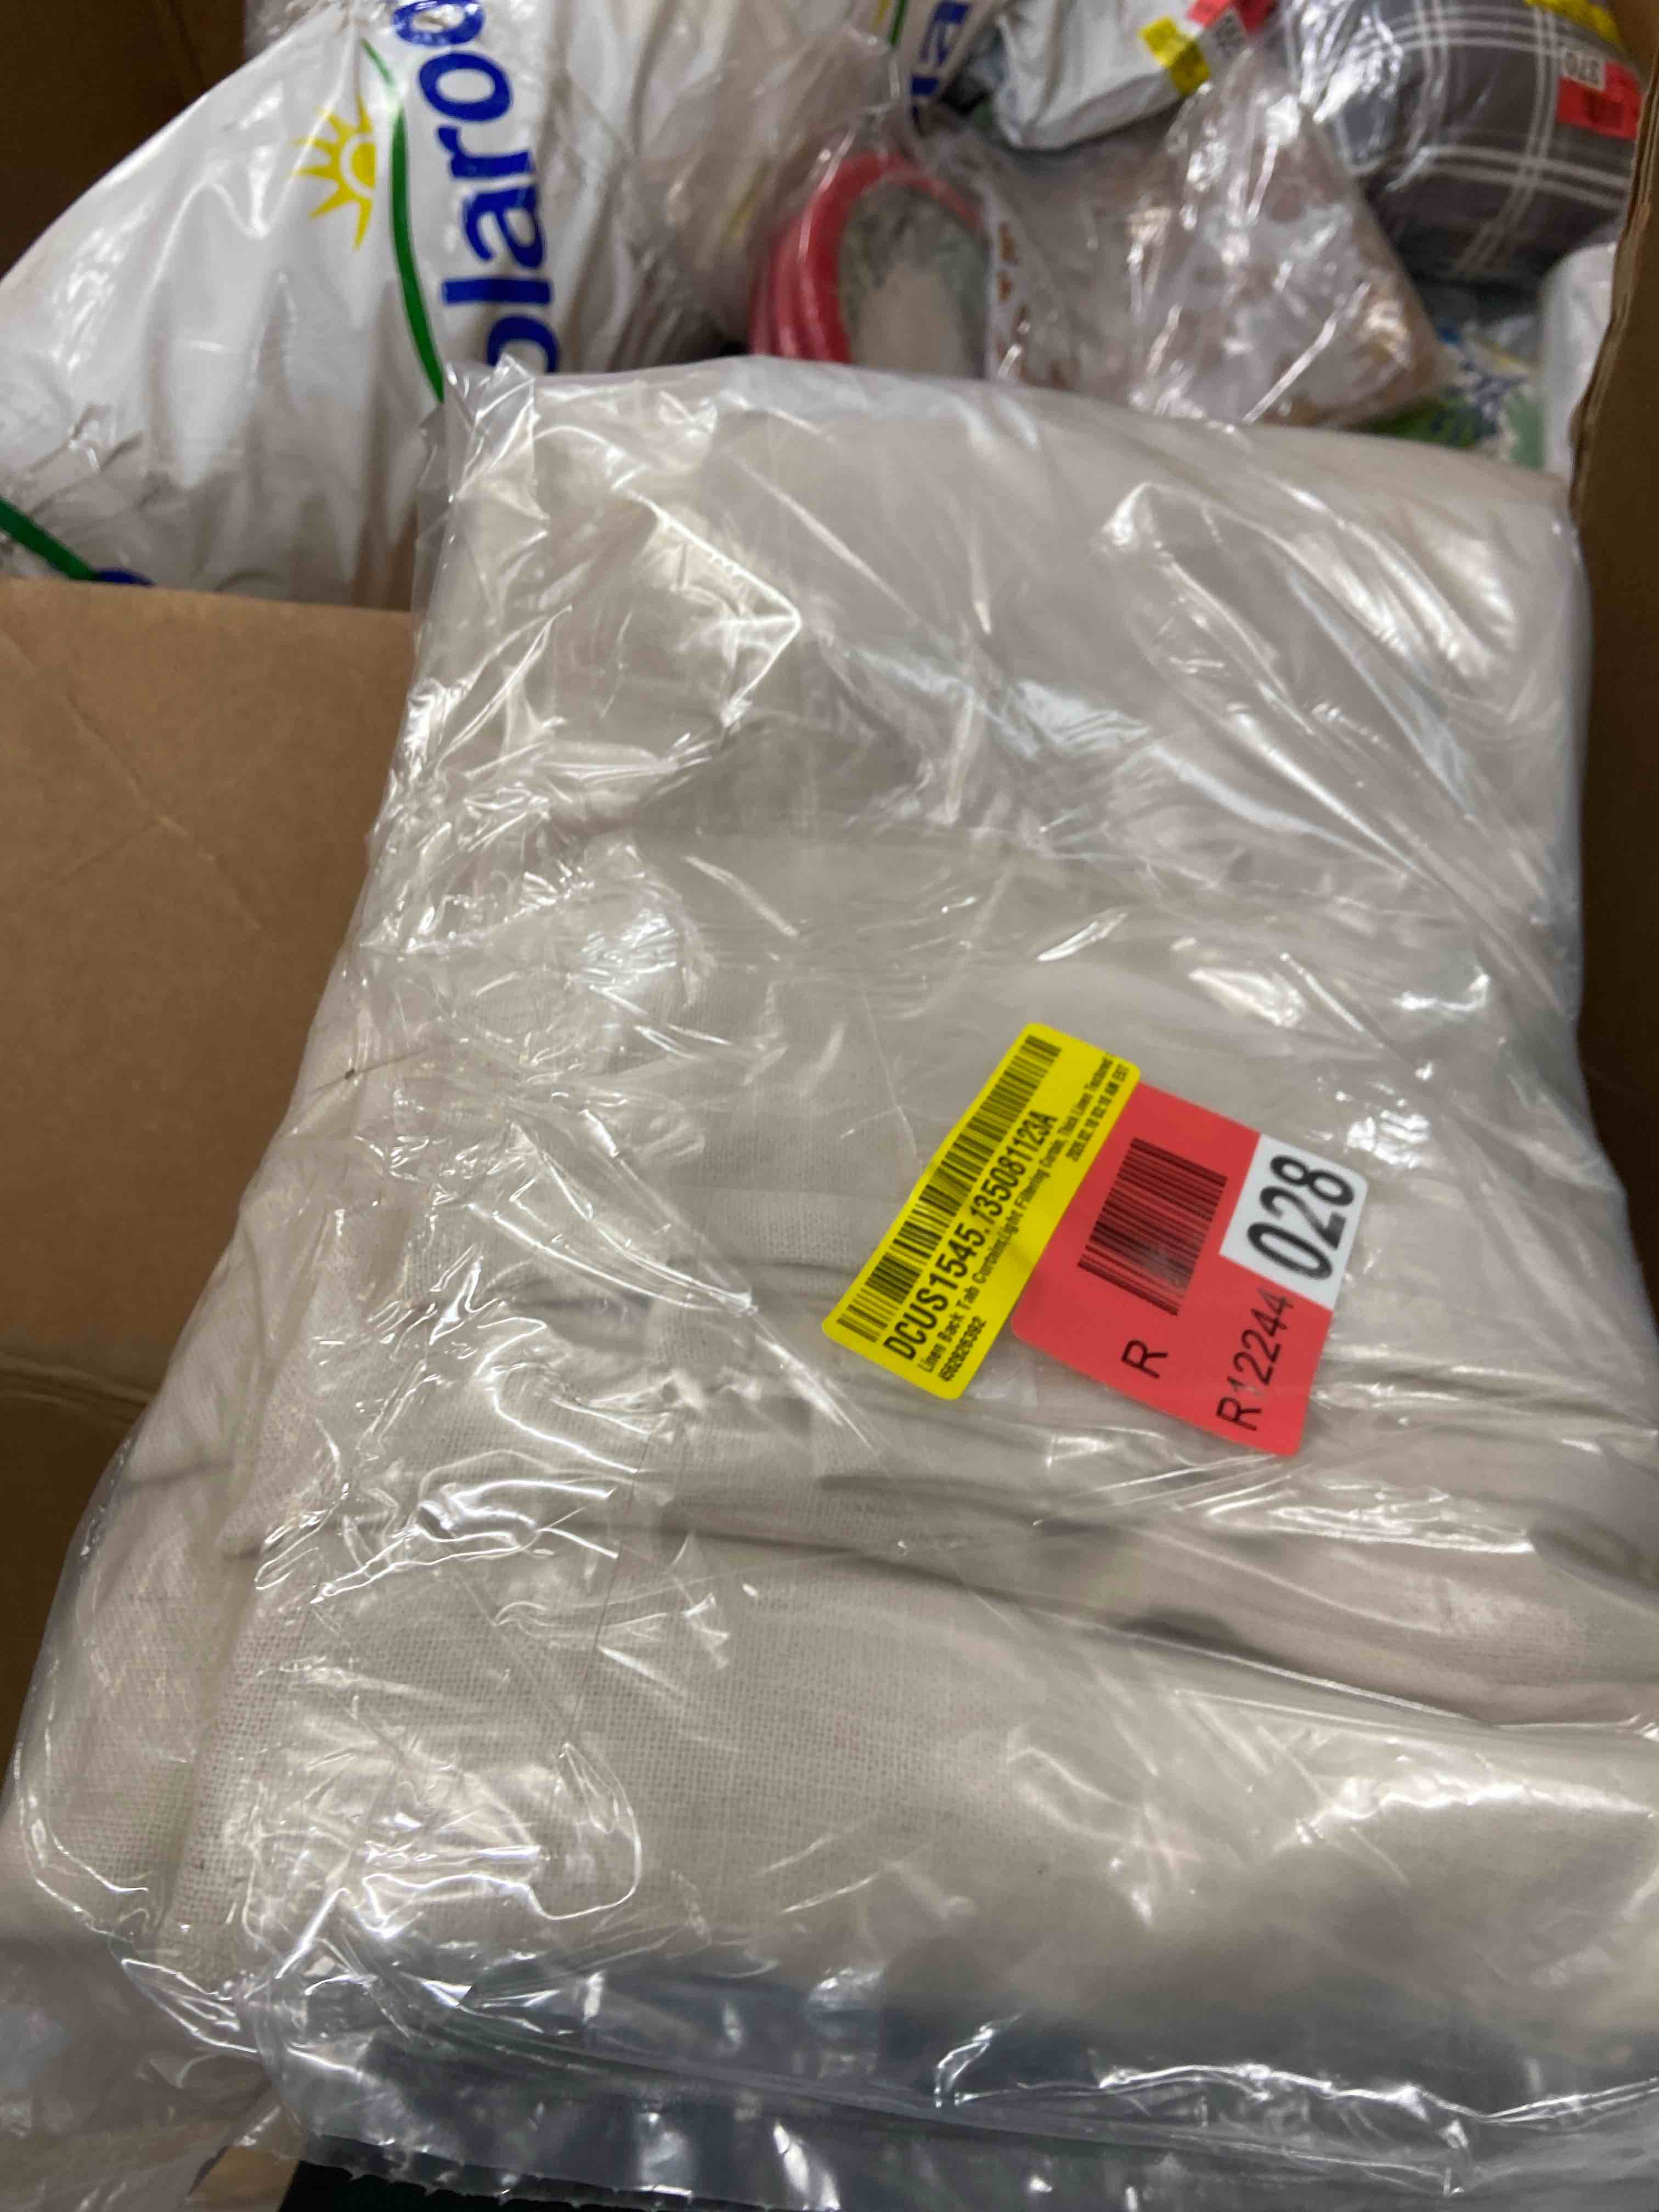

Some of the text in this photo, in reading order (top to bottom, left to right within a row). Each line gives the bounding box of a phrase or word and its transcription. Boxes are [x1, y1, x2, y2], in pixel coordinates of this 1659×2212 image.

[883, 1111, 1059, 1361] DCUS1545.135081123A
[1247, 1155, 1354, 1279] 028
[937, 1312, 964, 1343] Back
[956, 1286, 979, 1310] Tab
[1121, 1340, 1168, 1378] R
